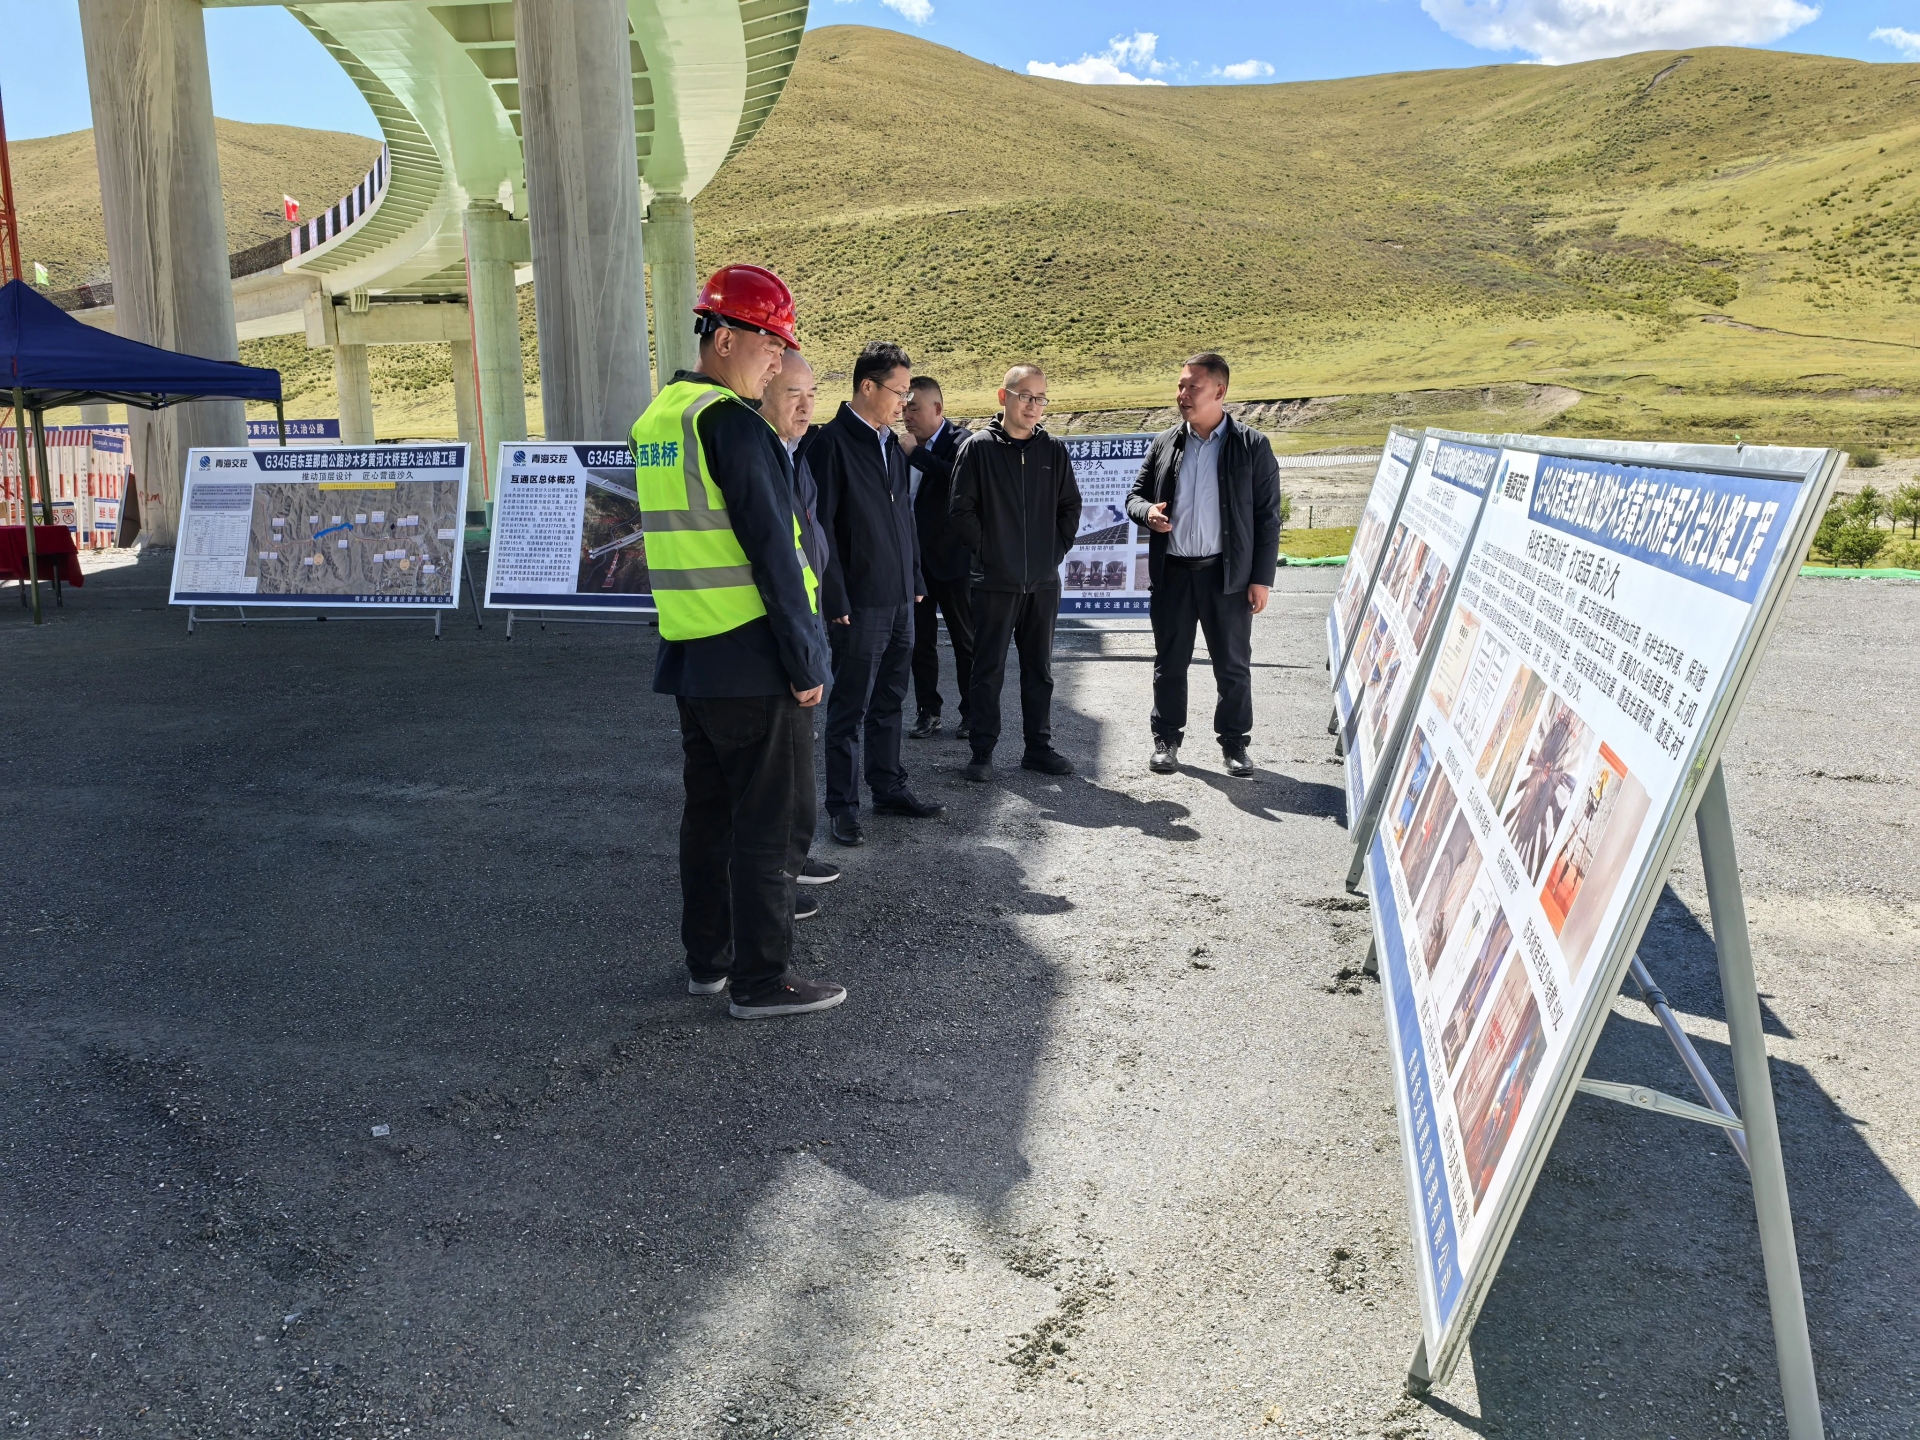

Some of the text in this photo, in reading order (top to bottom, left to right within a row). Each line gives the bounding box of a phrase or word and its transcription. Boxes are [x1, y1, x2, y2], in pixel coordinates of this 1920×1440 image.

[265, 450, 457, 469] G345启东至那曲公路沙木多黄河大桥至久治公路工程
[531, 454, 568, 464] 青海交控
[587, 450, 635, 466] G345启东
[636, 441, 679, 468] 西路桥
[215, 459, 248, 468] 青海交控
[302, 471, 414, 481] 推动顶层设计 匠心营造沙久
[511, 475, 575, 484] 互通区总体概况
